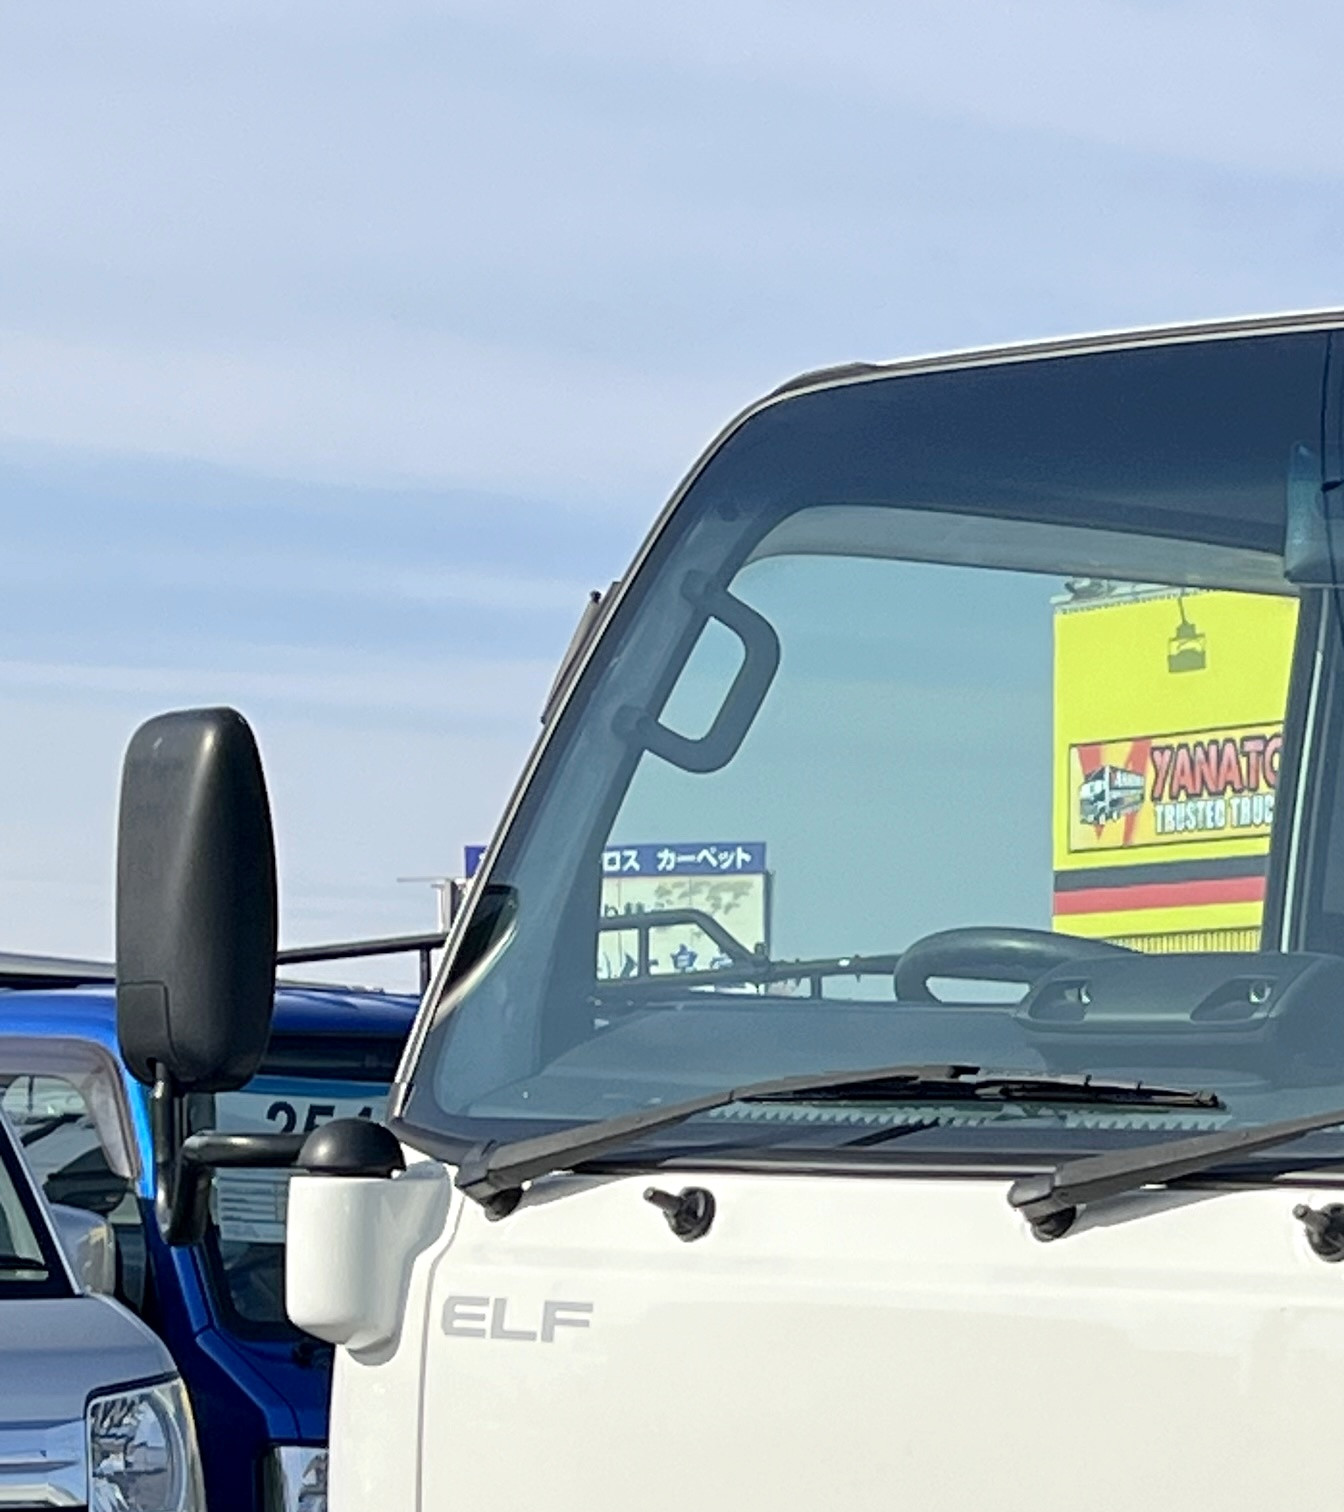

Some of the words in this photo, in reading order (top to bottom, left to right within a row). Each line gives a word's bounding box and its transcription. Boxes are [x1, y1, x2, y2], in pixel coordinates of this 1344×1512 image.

[1154, 798, 1227, 835] TRUSTED
[656, 847, 752, 870] カーペット
[441, 1296, 593, 1343] ELF
